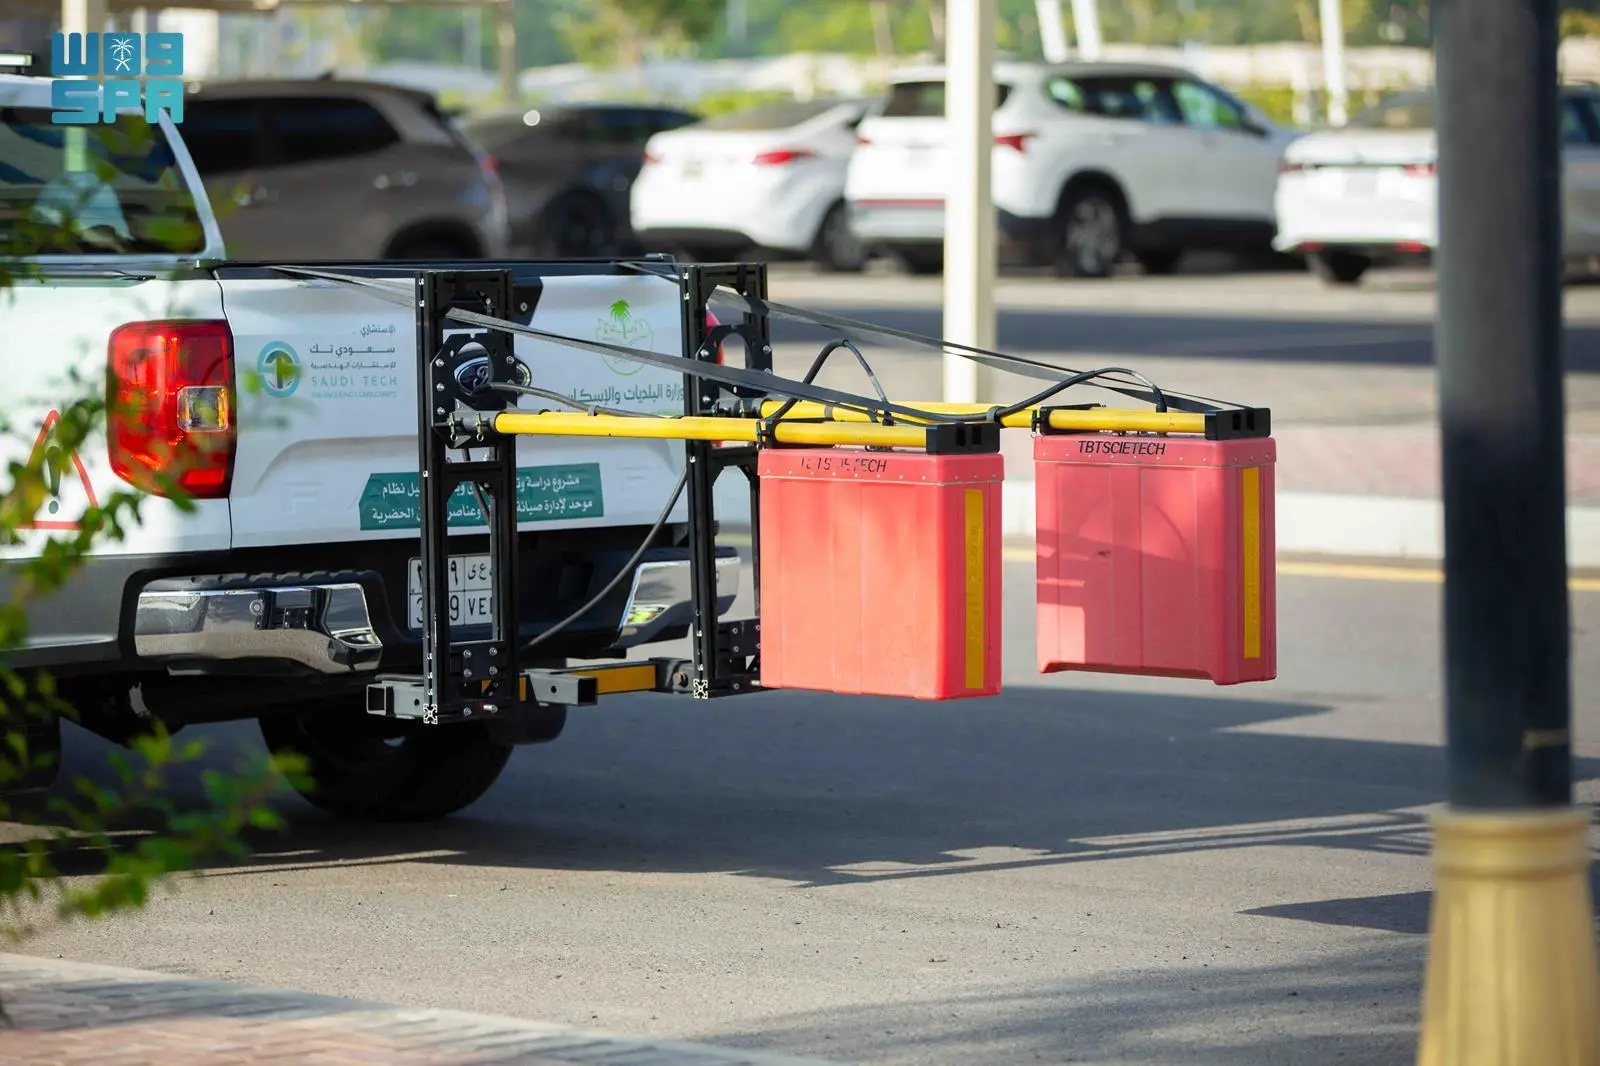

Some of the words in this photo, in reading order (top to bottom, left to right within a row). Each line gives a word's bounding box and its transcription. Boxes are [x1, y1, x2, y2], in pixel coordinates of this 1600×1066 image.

[311, 376, 354, 387] SAUDI
[363, 375, 397, 386] TECH
[623, 384, 662, 404] البلديات
[1078, 440, 1166, 455] TBTSCIETECH
[382, 482, 405, 500] نظام
[526, 475, 551, 491] دراسة
[552, 474, 580, 493] مشروع
[447, 504, 481, 521] وعناصر
[544, 497, 566, 514] لإدارة
[569, 499, 593, 512] موحد
[371, 507, 414, 524] الحضرية
